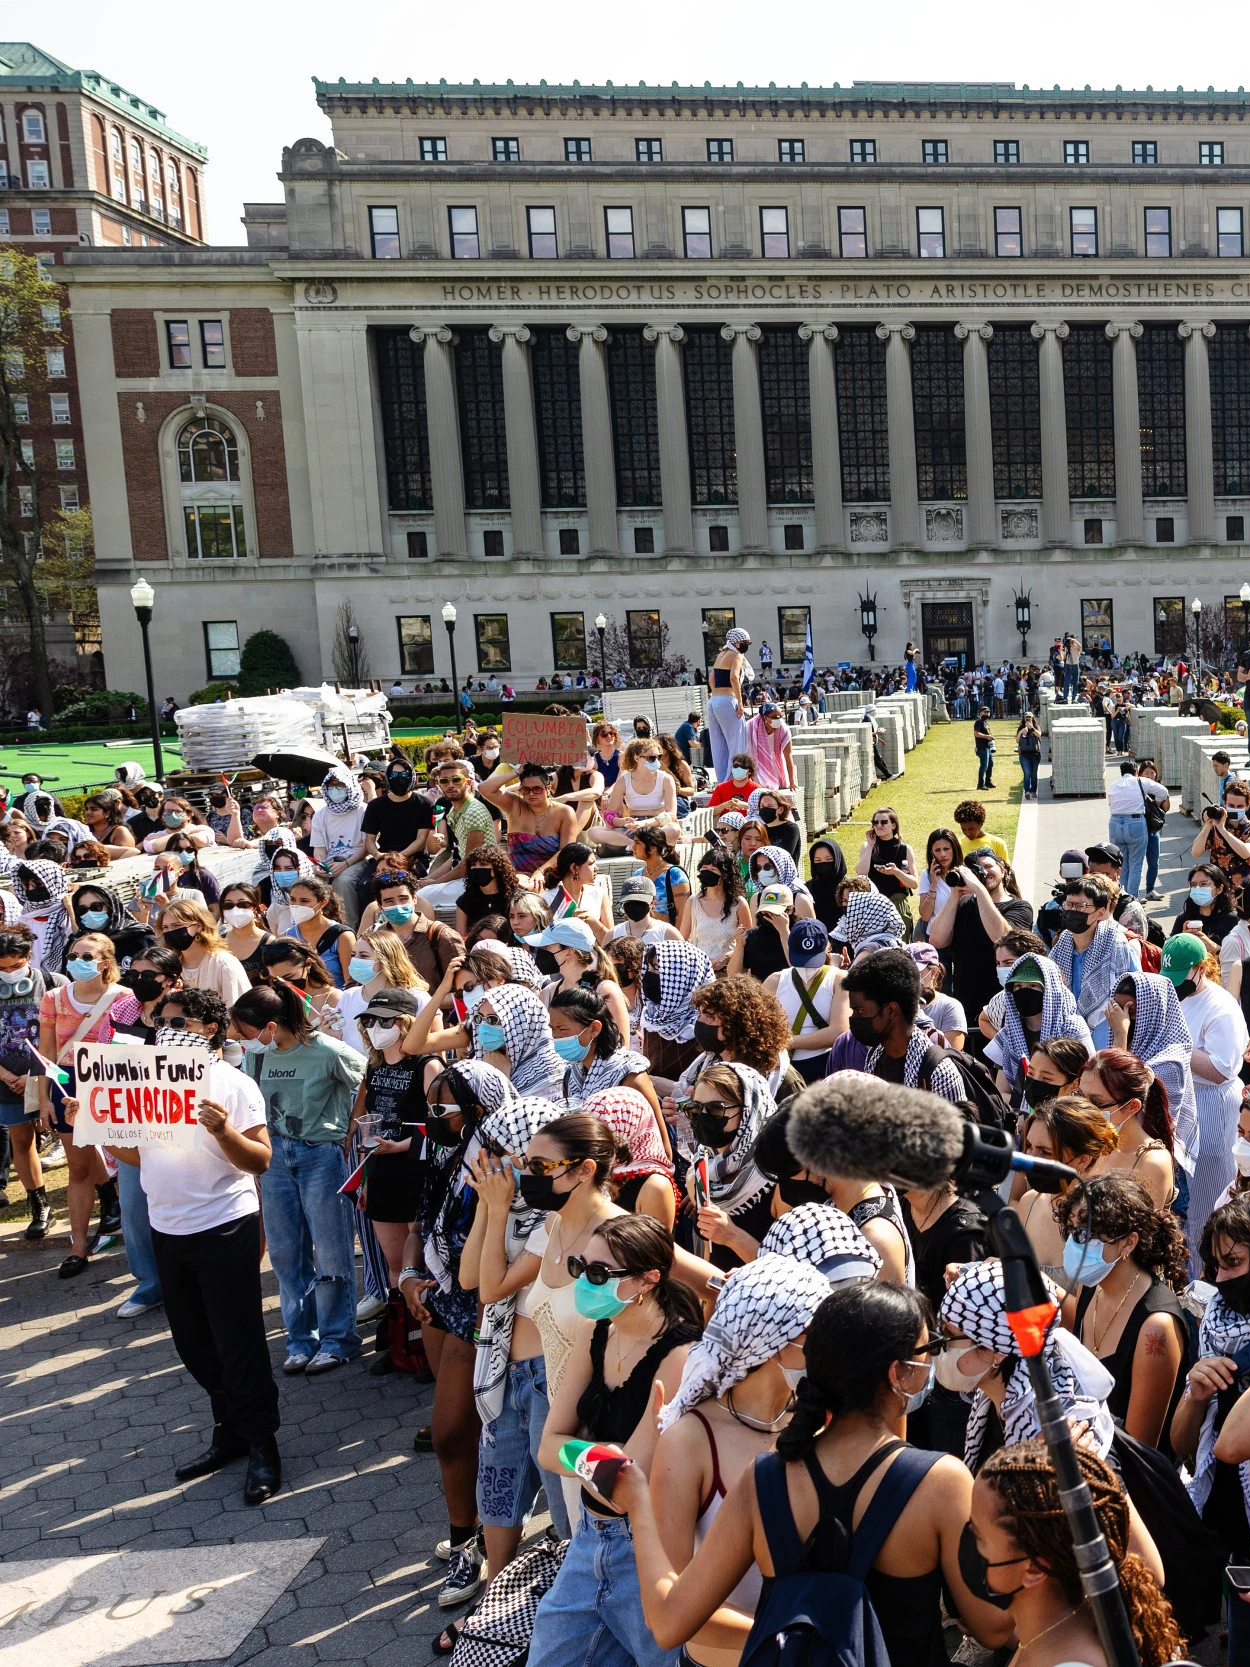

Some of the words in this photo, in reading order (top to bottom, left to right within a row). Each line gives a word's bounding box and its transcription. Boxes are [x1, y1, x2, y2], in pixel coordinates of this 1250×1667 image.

[442, 285, 523, 301] HOMER
[538, 285, 676, 300] HERODOTUS
[694, 284, 822, 299] SOPHOCLES
[841, 284, 911, 299] PLATO
[930, 283, 1046, 298] ARISTOTLE
[1061, 283, 1215, 298] DEMOSTHENES
[507, 717, 585, 736] COLUMBIA
[516, 737, 563, 752] FUNDS
[77, 1047, 151, 1083] Columbia
[155, 1055, 205, 1083] Funds
[268, 1068, 297, 1079] blond
[89, 1086, 198, 1125] GENOCIDE
